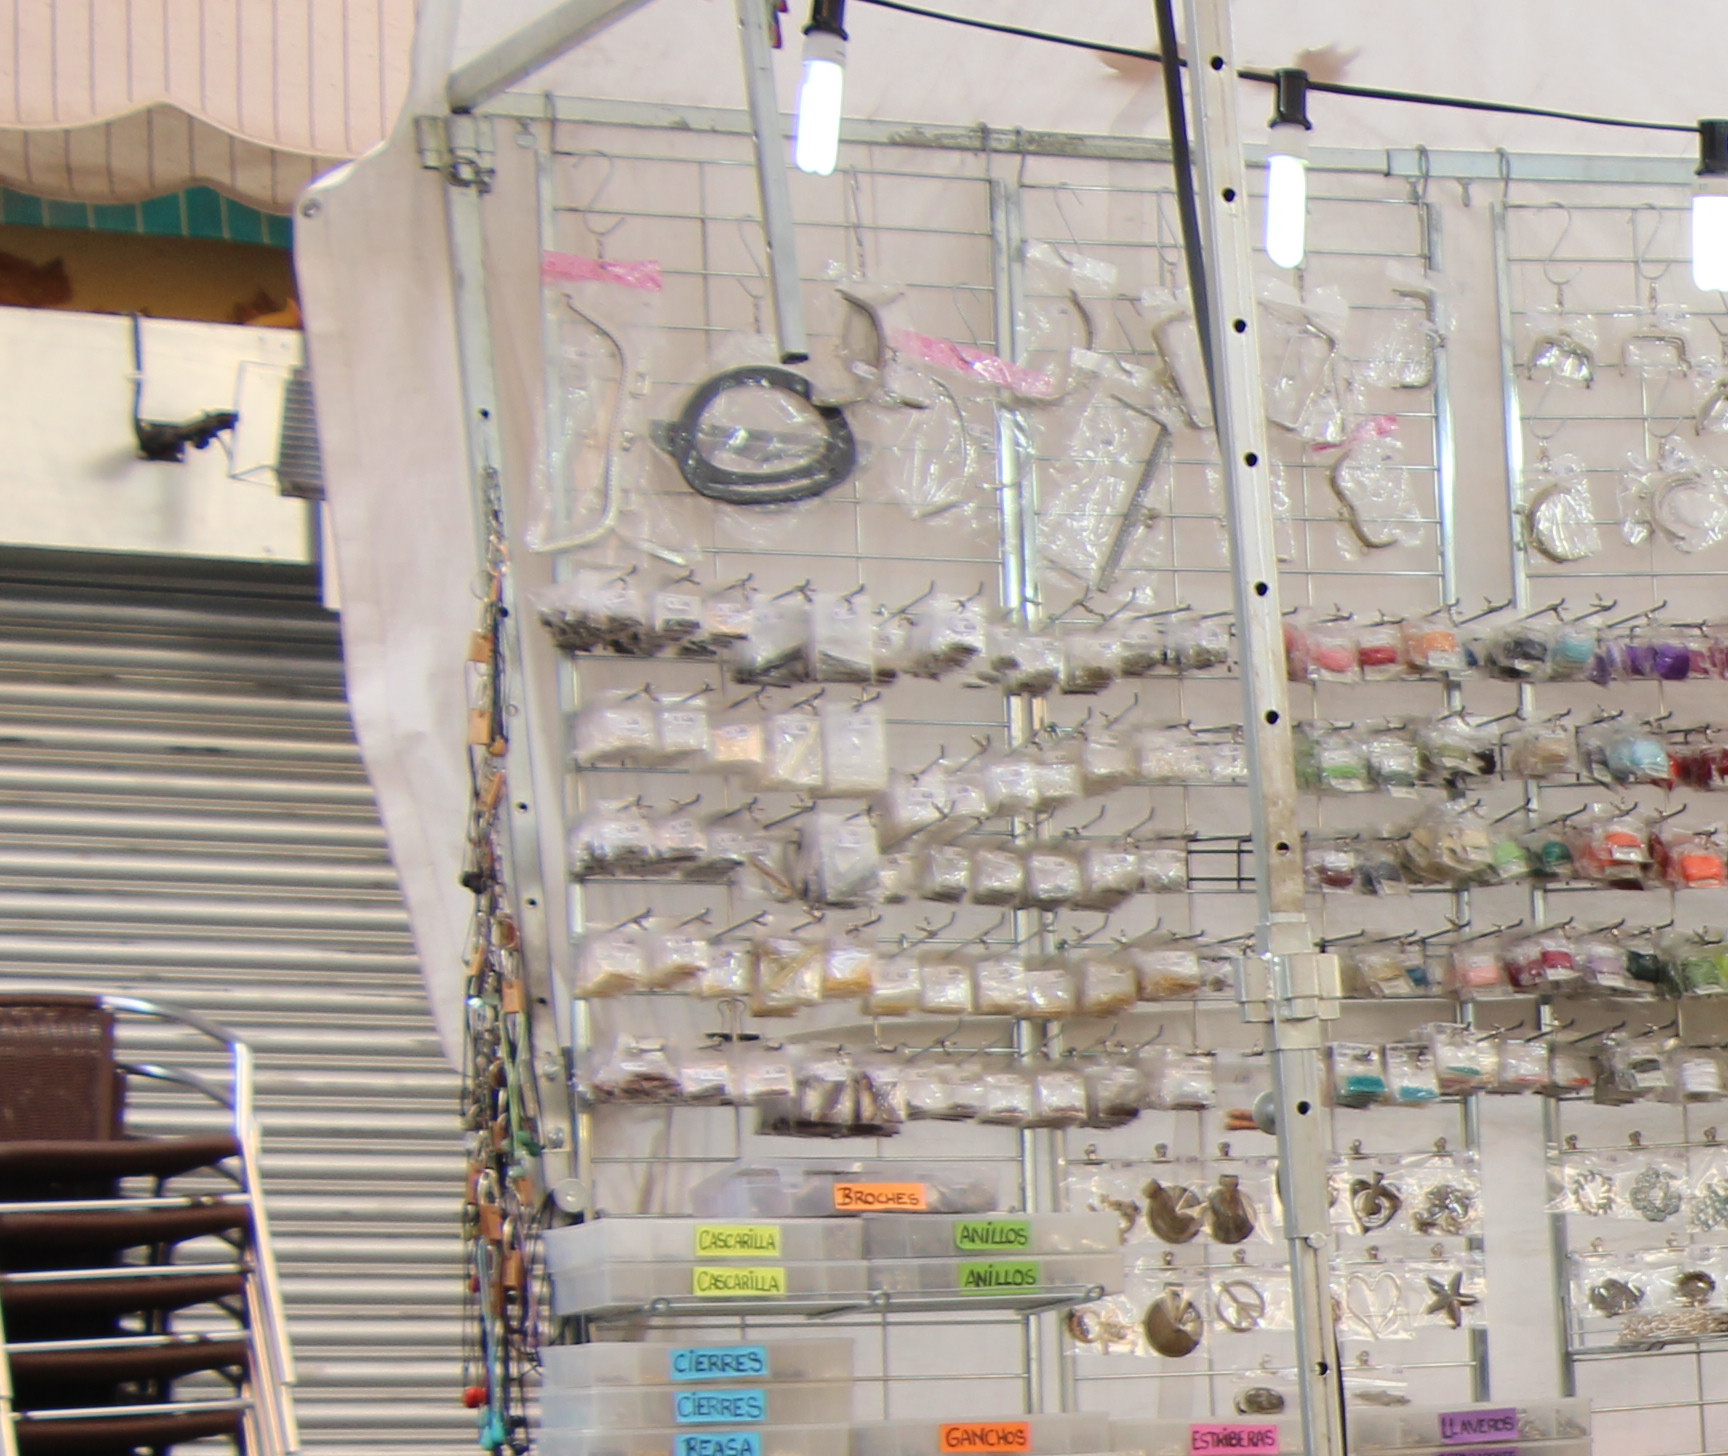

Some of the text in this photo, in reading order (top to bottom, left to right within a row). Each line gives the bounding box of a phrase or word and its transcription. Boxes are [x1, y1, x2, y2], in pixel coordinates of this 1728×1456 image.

[838, 1187, 920, 1206] BROCHES
[700, 1228, 776, 1250] CASCARILLA
[960, 1221, 1028, 1246] ANILLOS
[697, 1270, 780, 1292] CASCARILLA
[964, 1264, 1036, 1287] ANILLOS
[673, 1349, 763, 1373] CIERRES
[677, 1392, 762, 1418] CIERRES
[945, 1427, 1026, 1447] GANCHOS
[1441, 1416, 1515, 1439] LLAVEROS
[1192, 1428, 1275, 1450] ESTRIBERAS
